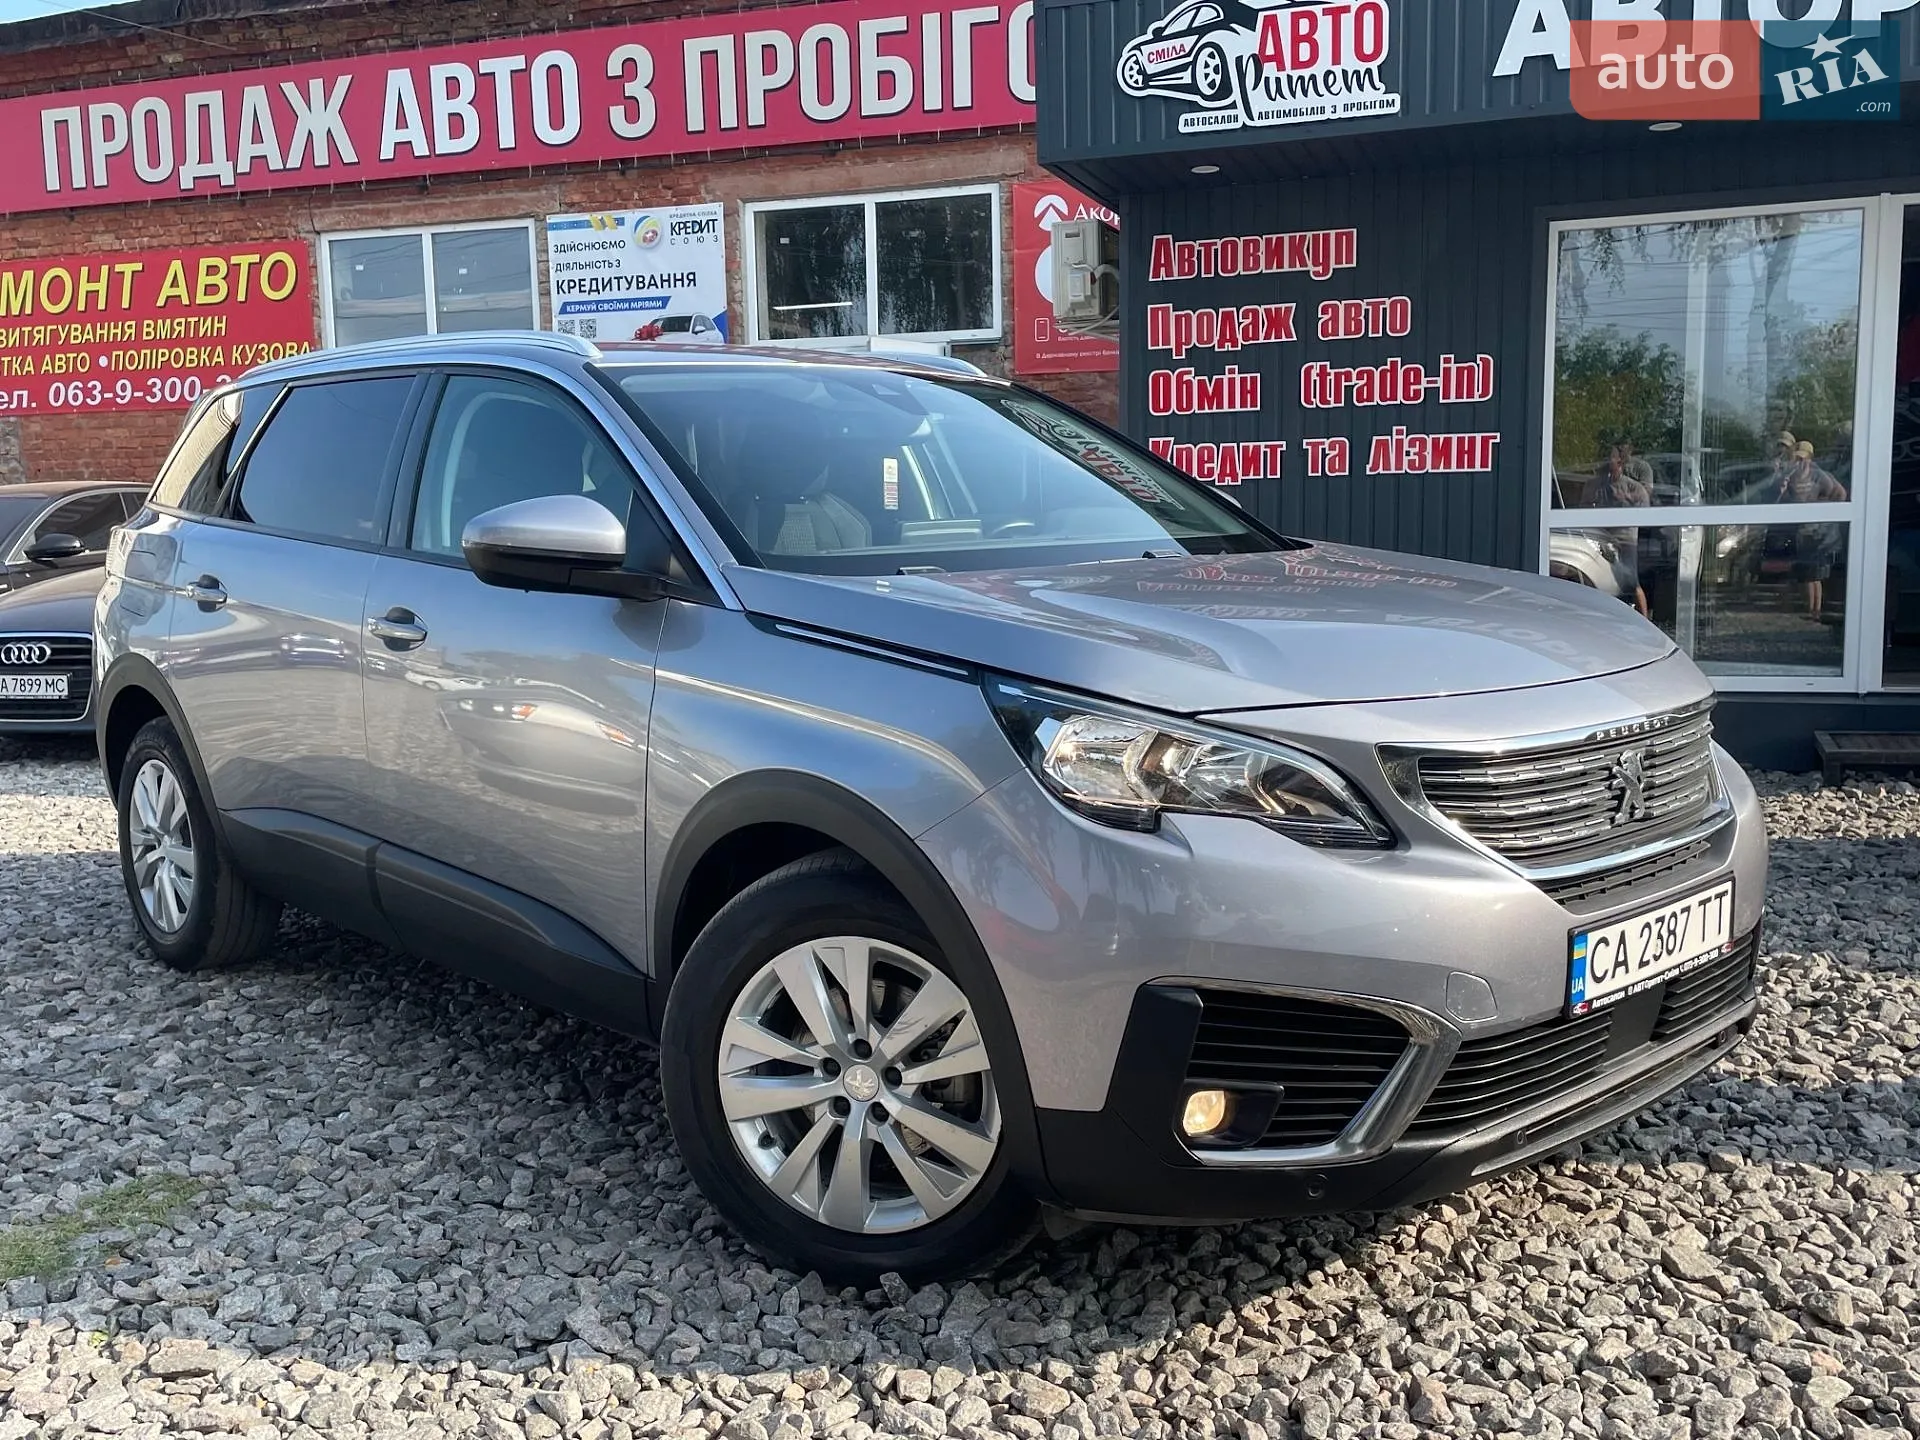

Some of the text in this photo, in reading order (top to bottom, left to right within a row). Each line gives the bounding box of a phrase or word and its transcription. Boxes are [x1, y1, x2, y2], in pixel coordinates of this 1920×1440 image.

[1257, 2, 1384, 73] АВТО
[1147, 43, 1187, 64] СМІЛА
[40, 74, 359, 192] ПРОДАЖ
[379, 49, 581, 161] АВТО
[1183, 114, 1239, 128] АВТОСАЛОН
[1257, 105, 1326, 121] АВТОМОБІЛІВ
[1343, 98, 1396, 113] ПРОБІГОМ
[553, 239, 626, 254] ЗДІЙСНЮЄМО
[1149, 228, 1357, 281] Автовикуп
[554, 260, 613, 273] ДІЯЛЬНІСТЬ
[0, 251, 297, 316] МОНТ АВТО
[556, 271, 697, 295] КРЕДИТУВАННЯ
[566, 299, 663, 313] КЕРМУЙ СВОЇМИ МРІЯМИ
[142, 315, 227, 341] ВМЯТИН
[1147, 296, 1411, 359] Продаж авто
[40, 352, 91, 375] АВТО
[111, 345, 225, 372] ПОЛІРОВКА
[1149, 354, 1493, 415] Обмін (trade-in)
[1303, 436, 1350, 477] та
[1366, 425, 1500, 476] лізинг
[12, 678, 41, 693] 7899
[45, 678, 65, 693] MC
[1596, 716, 1669, 740] PEUGEOT
[1590, 889, 1729, 984] CA 2387 TT
[1571, 976, 1584, 994] UA
